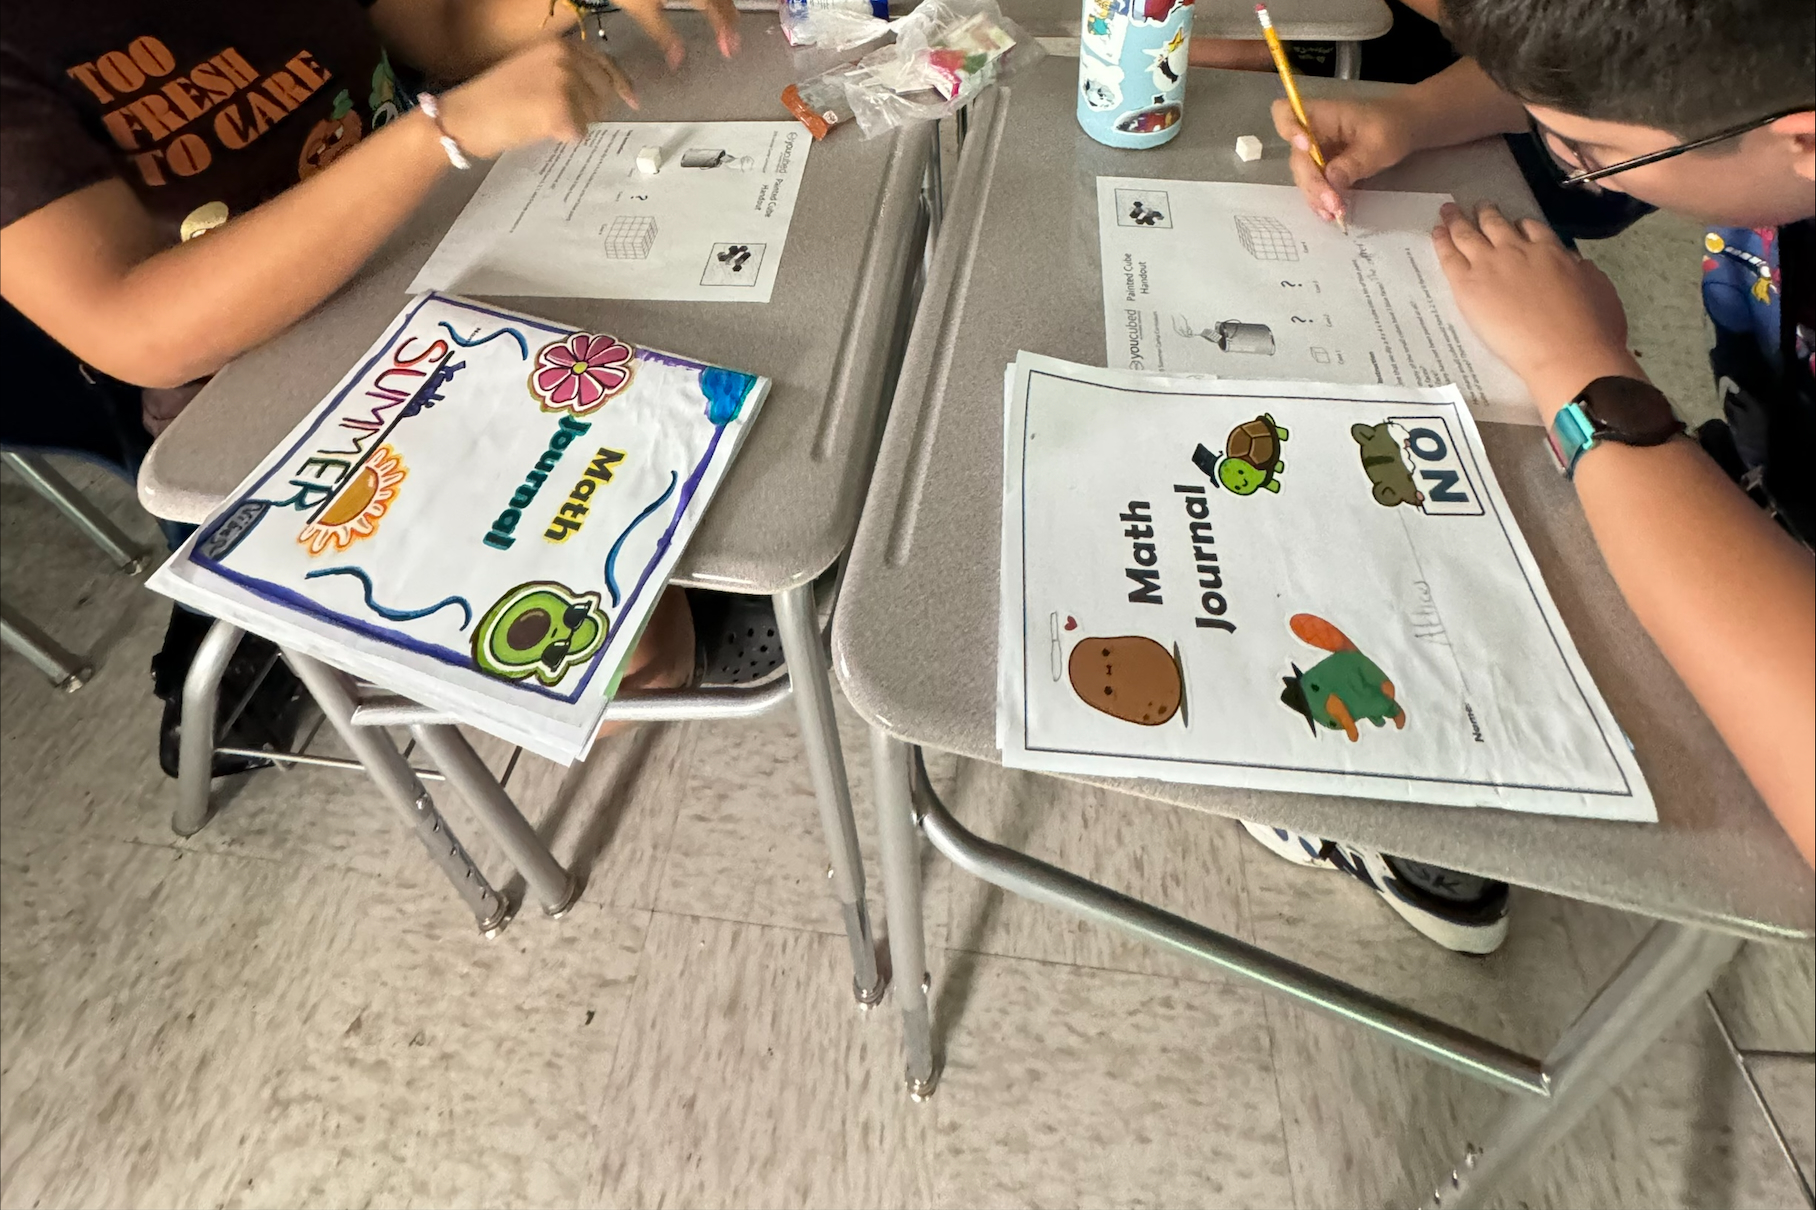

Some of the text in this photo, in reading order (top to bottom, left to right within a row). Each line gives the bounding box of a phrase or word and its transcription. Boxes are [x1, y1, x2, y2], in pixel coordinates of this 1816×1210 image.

[66, 35, 176, 104] TOO
[103, 47, 260, 150] FRESH
[131, 49, 333, 186] TO CARE
[1123, 253, 1135, 301] Painted Cube
[1138, 262, 1148, 294] Handout
[1126, 309, 1144, 359] youcubed
[287, 336, 449, 511] SUMMER
[1409, 427, 1468, 504] NO
[484, 415, 592, 550] Journal
[544, 448, 625, 542] Math
[1120, 500, 1163, 606] Math
[1173, 484, 1237, 634] Journal
